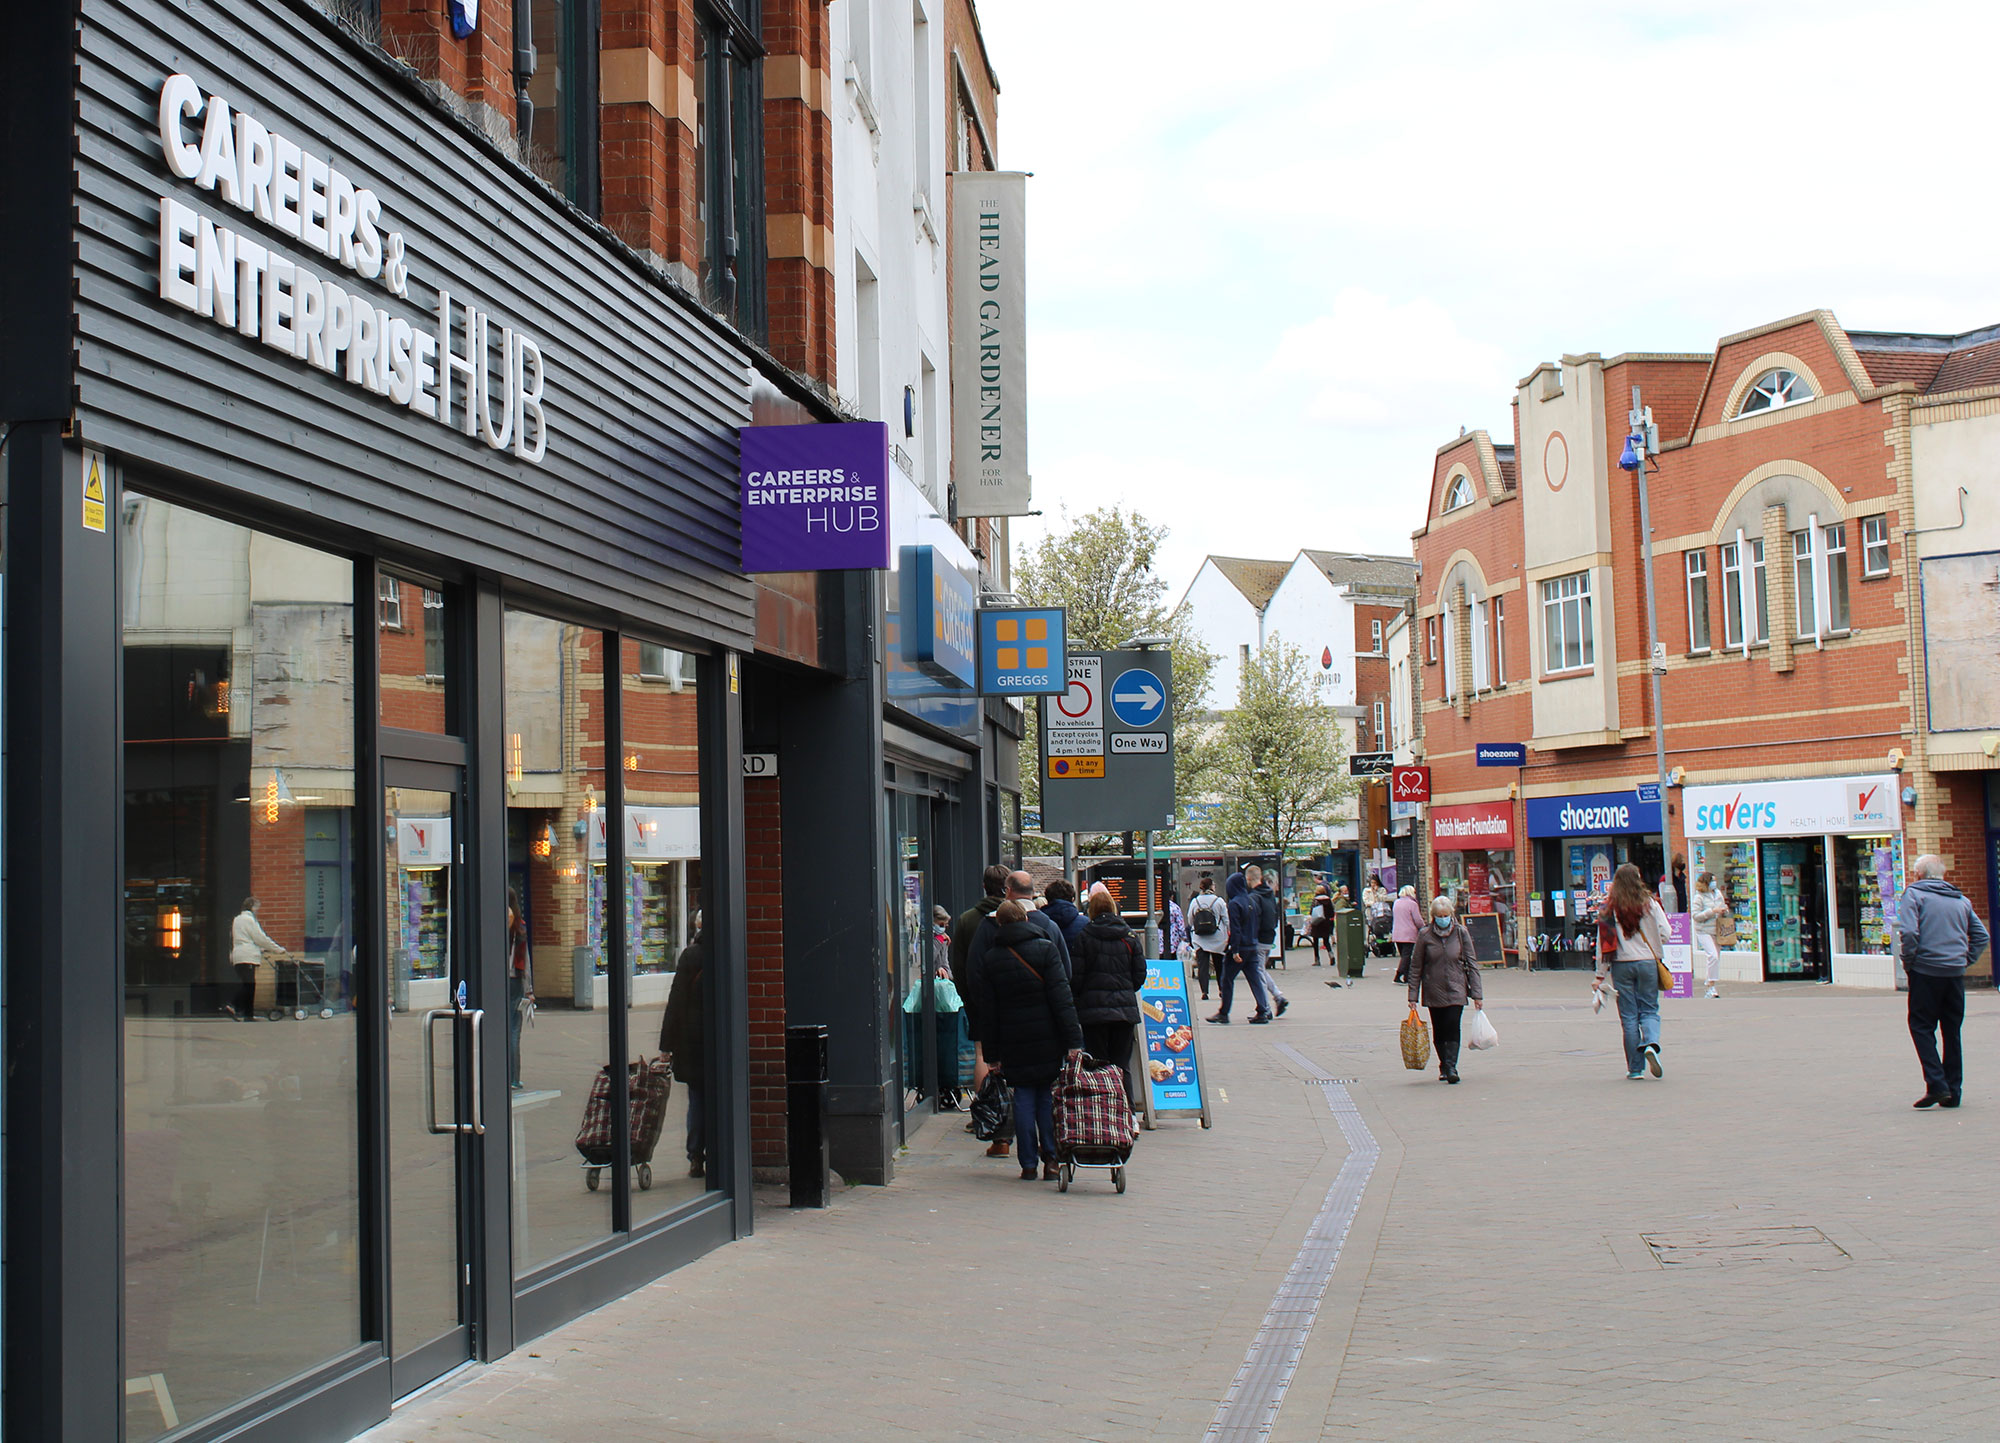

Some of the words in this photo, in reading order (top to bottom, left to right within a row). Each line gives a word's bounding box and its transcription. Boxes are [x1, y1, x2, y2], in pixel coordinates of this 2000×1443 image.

[160, 74, 381, 279] CAREERS
[385, 232, 408, 299] &
[979, 199, 999, 208] THE
[979, 212, 1000, 292] HEAD
[160, 198, 437, 417] ENTERPRISE
[439, 290, 546, 463] HUB
[979, 300, 1002, 464] GARDENER
[747, 469, 845, 487] CAREERS
[850, 471, 861, 484] &
[982, 469, 1001, 477] FOR
[980, 478, 1003, 487] HAIR
[748, 486, 877, 505] ENTERPRISE
[807, 505, 880, 533] HUB
[997, 675, 1049, 687] GREGGS
[1075, 738, 1101, 746] loading
[1114, 737, 1138, 749] One
[1140, 737, 1164, 751] Way
[1479, 749, 1520, 758] shoezone
[1559, 802, 1629, 832] shoezone
[1695, 791, 1776, 831] savers
[1853, 810, 1884, 821] savers
[1435, 817, 1454, 837] British
[1454, 817, 1471, 836] Heart
[1471, 814, 1508, 835] Foundation
[1790, 818, 1816, 827] HEALTH
[1826, 816, 1846, 825] HOME
[1143, 976, 1181, 990] DEALS
